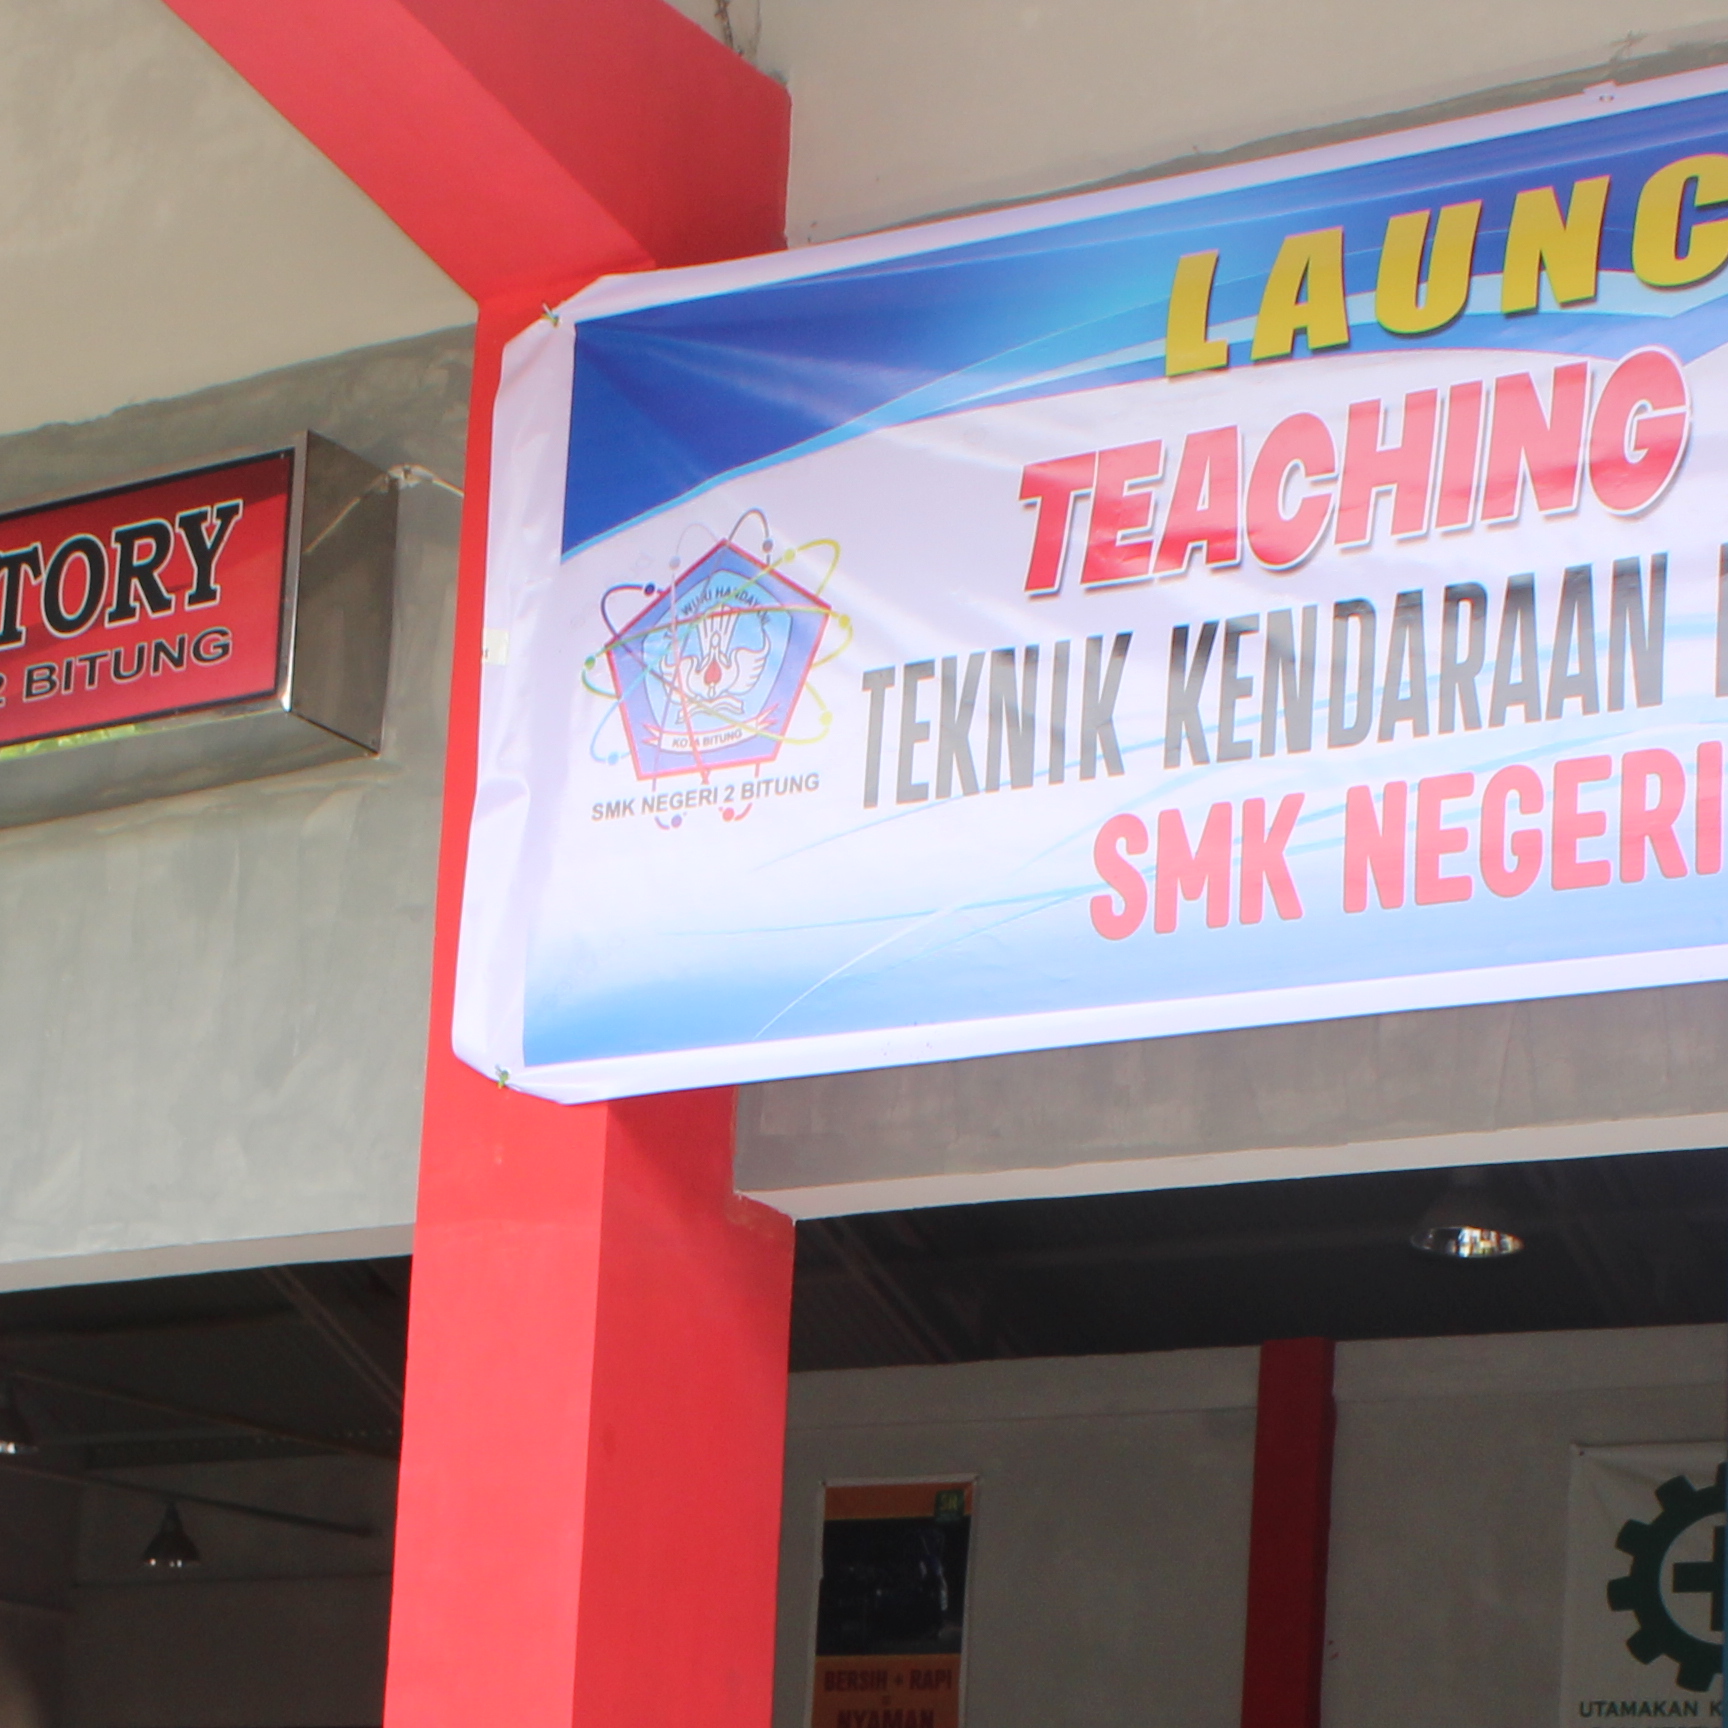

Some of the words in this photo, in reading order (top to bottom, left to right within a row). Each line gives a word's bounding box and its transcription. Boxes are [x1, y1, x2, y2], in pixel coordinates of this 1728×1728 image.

[1017, 346, 1694, 598] TEACHING
[22, 626, 233, 702] BITUNG
[861, 631, 1134, 809] TEKNIK
[1163, 552, 1668, 769] KENDARAAN
[703, 727, 744, 748] BITUNG
[591, 798, 635, 821] SMK
[641, 787, 718, 815] NEGERI
[723, 784, 735, 803] 2
[741, 772, 819, 801] BITUNG
[1088, 797, 1303, 941] SMK
[1342, 738, 1723, 914] NEGERI
[824, 1670, 888, 1692] BERSIH
[909, 1669, 952, 1690] RAPI
[1579, 1700, 1698, 1718] UTAMAKAN
